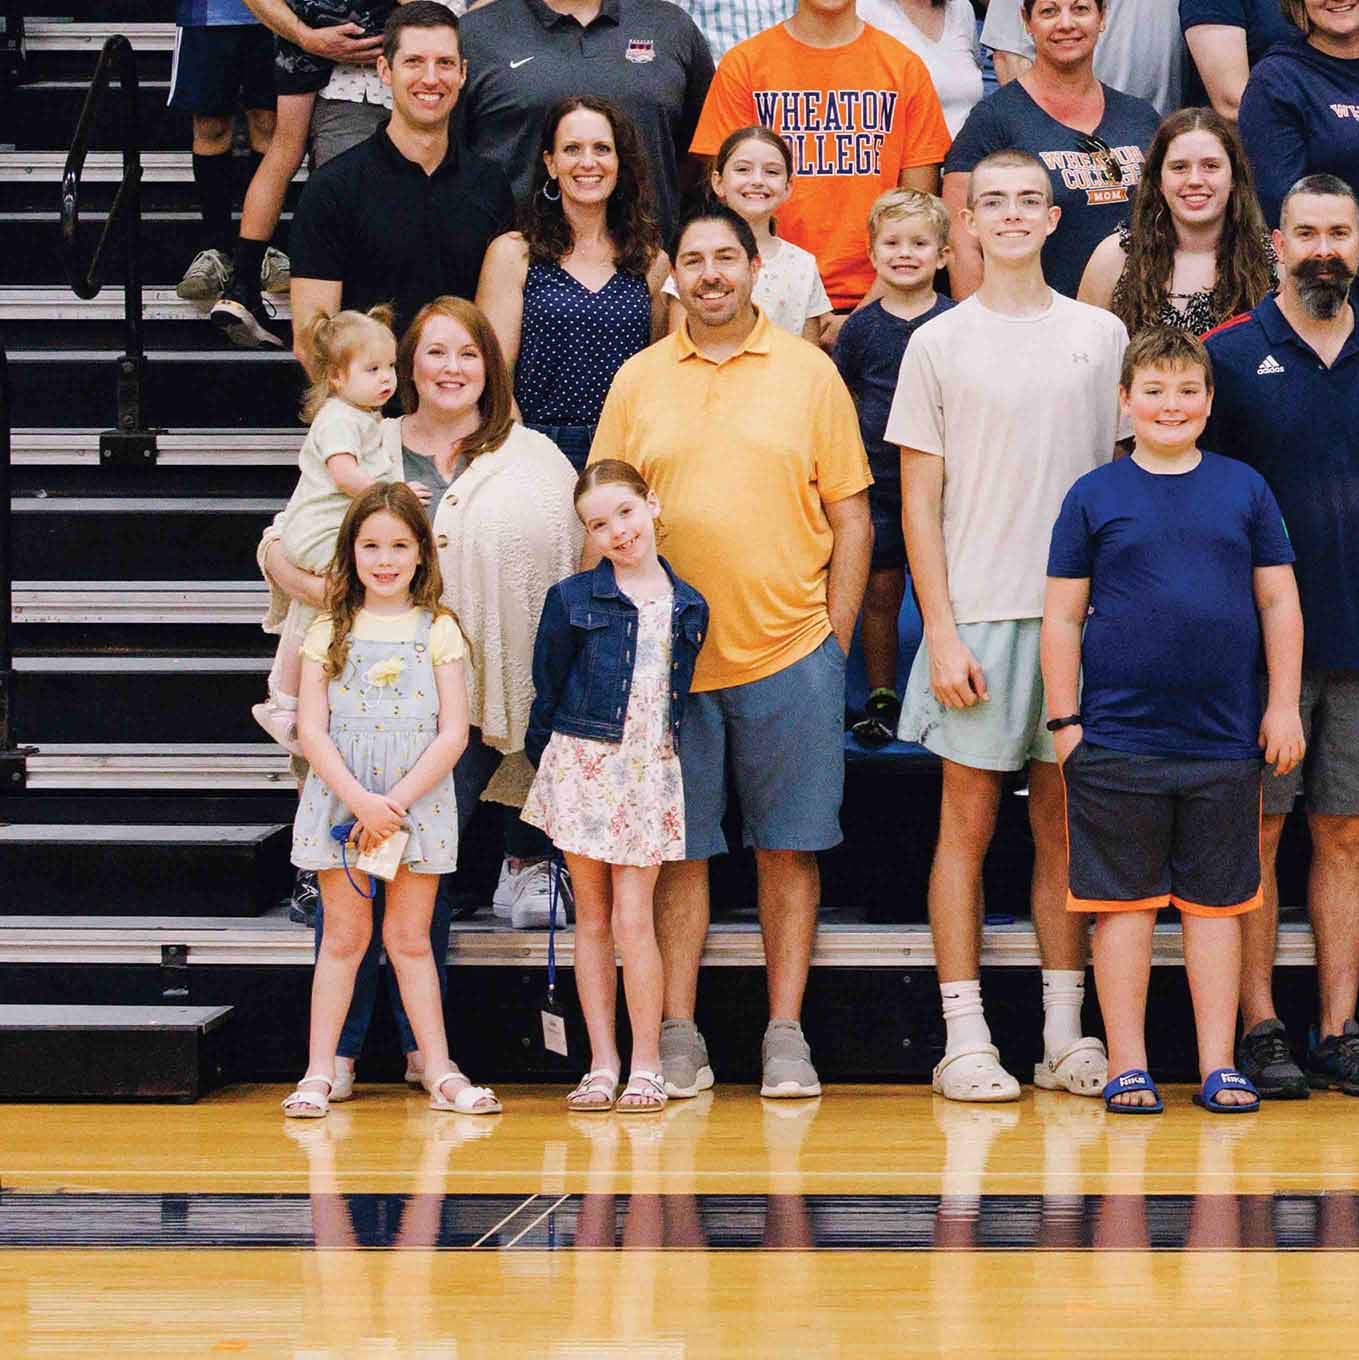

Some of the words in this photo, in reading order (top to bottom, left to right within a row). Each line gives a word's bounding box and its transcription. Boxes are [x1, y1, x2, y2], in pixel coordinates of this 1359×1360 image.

[754, 89, 898, 134] WHEATON
[1093, 191, 1122, 203] MOM
[1257, 366, 1285, 376] adidas
